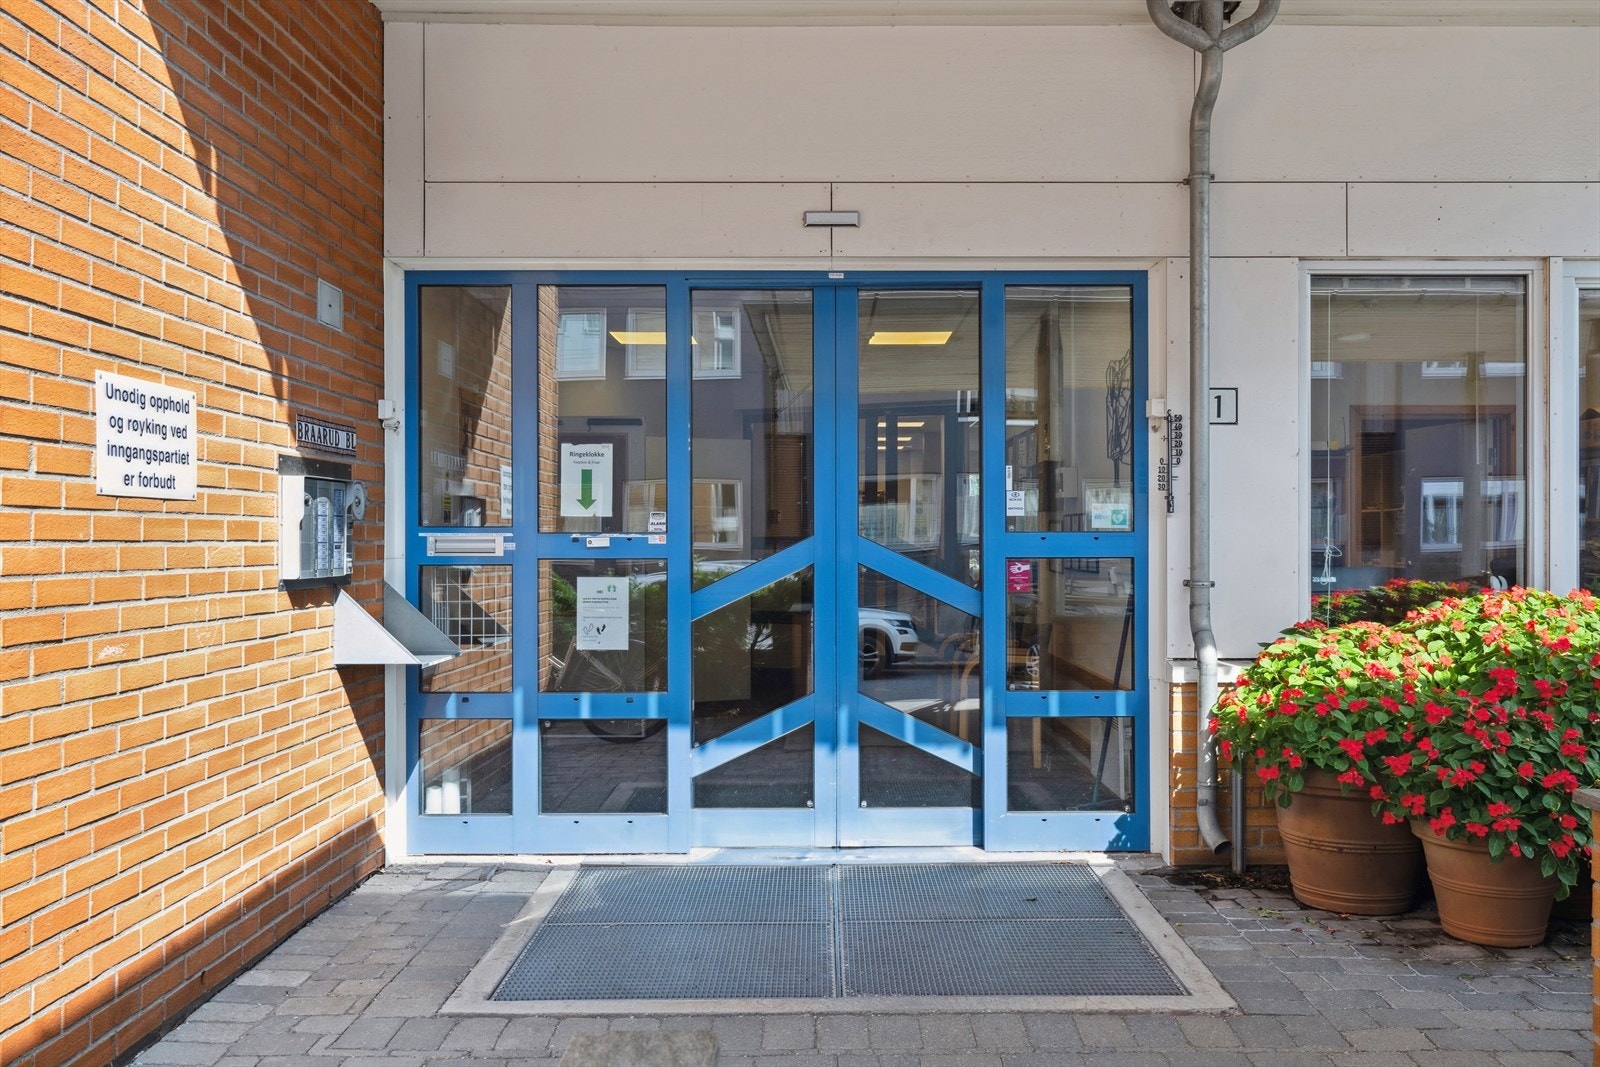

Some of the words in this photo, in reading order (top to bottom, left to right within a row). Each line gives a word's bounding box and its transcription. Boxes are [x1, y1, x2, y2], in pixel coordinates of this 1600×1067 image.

[105, 382, 146, 410] Unødig
[150, 396, 190, 414] opphold
[1214, 395, 1221, 418] 1
[109, 415, 123, 434] og
[127, 417, 167, 440] røyking
[170, 425, 187, 440] ved
[1174, 414, 1182, 422] 50
[297, 421, 340, 447] BRAARUD
[346, 432, 356, 449] BL
[107, 440, 190, 465] inngangspartiet
[123, 473, 135, 486] er
[138, 471, 176, 490] forbudt
[1158, 483, 1165, 491] 30
